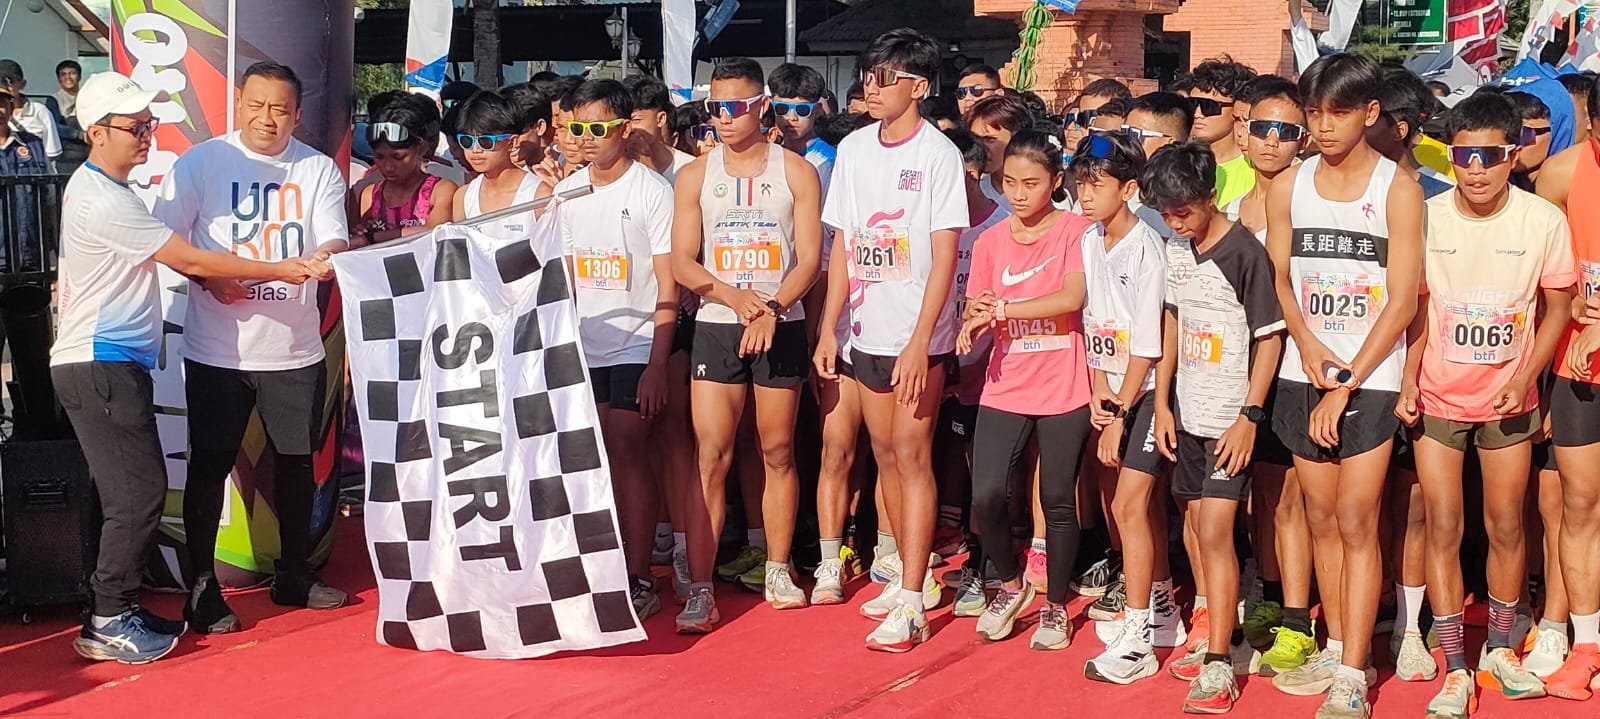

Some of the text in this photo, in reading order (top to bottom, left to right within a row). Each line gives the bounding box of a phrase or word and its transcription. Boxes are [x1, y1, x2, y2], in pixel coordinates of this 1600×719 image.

[1301, 233, 1376, 256] 長距離走
[721, 248, 770, 269] 0790
[856, 245, 894, 266] 0261
[584, 259, 621, 279] 1306
[736, 270, 754, 281] btn
[249, 285, 287, 301] elas
[1309, 292, 1367, 318] 0025
[1007, 318, 1057, 337] 0645
[1324, 319, 1345, 332] btn
[1454, 323, 1514, 347] 0063
[1023, 340, 1041, 350] btn
[1474, 349, 1496, 361] btn
[432, 322, 523, 572] START
